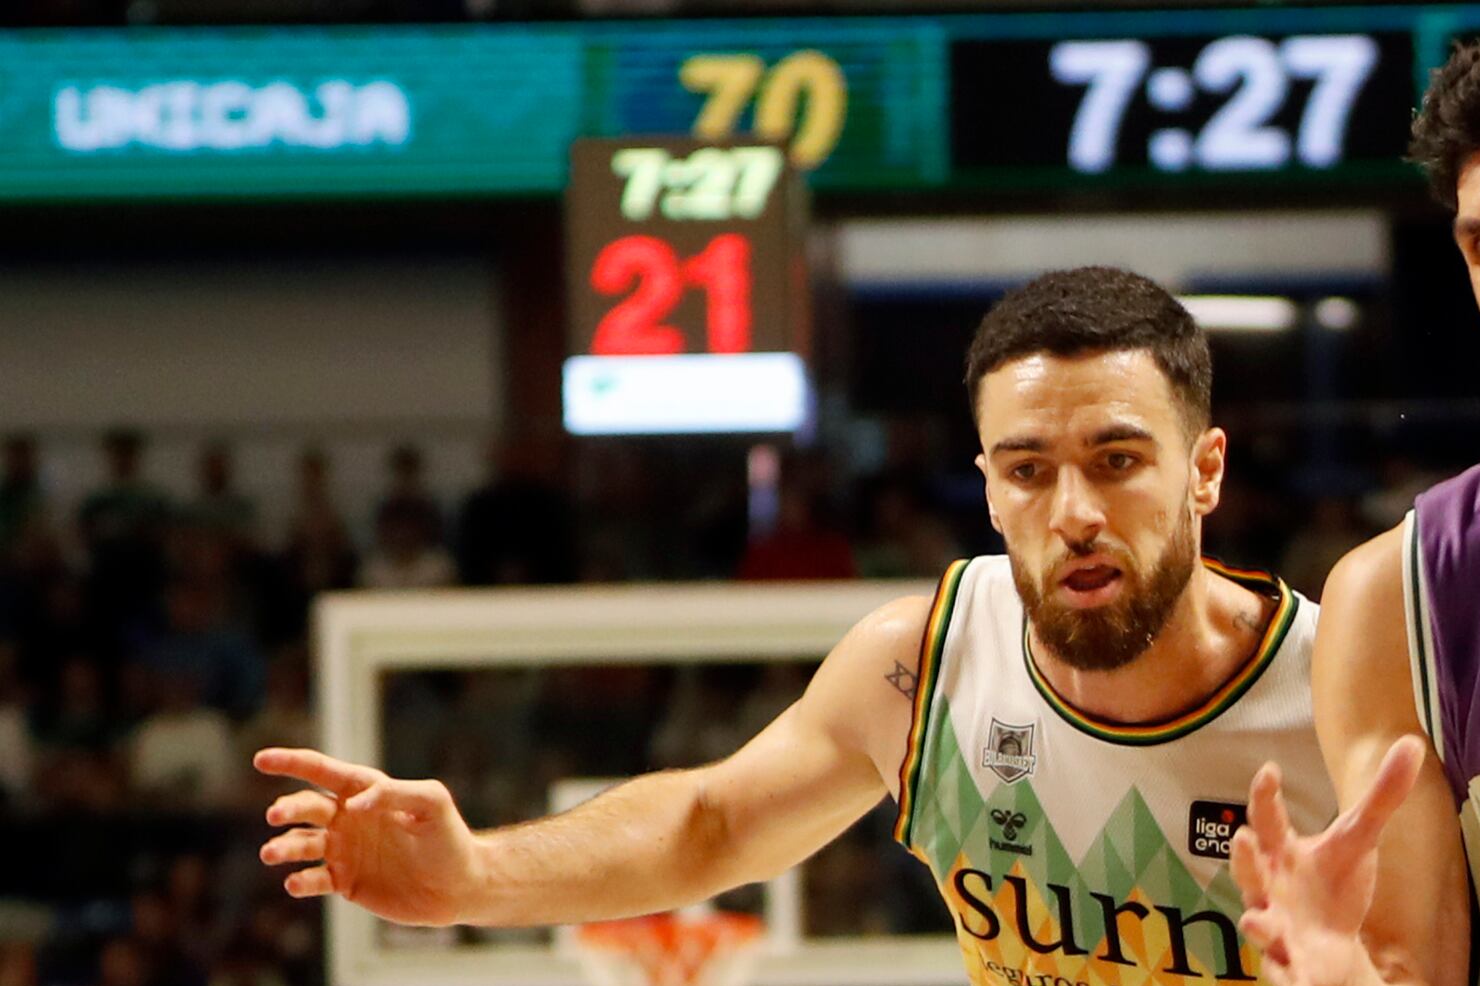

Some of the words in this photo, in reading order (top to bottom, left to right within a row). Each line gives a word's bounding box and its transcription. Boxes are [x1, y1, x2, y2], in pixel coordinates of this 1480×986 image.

[678, 50, 846, 167] 70
[1049, 35, 1378, 173] 7:27
[612, 146, 784, 220] 7:27
[590, 233, 755, 356] 21
[1196, 817, 1230, 838] liga
[953, 867, 1257, 982] surn
